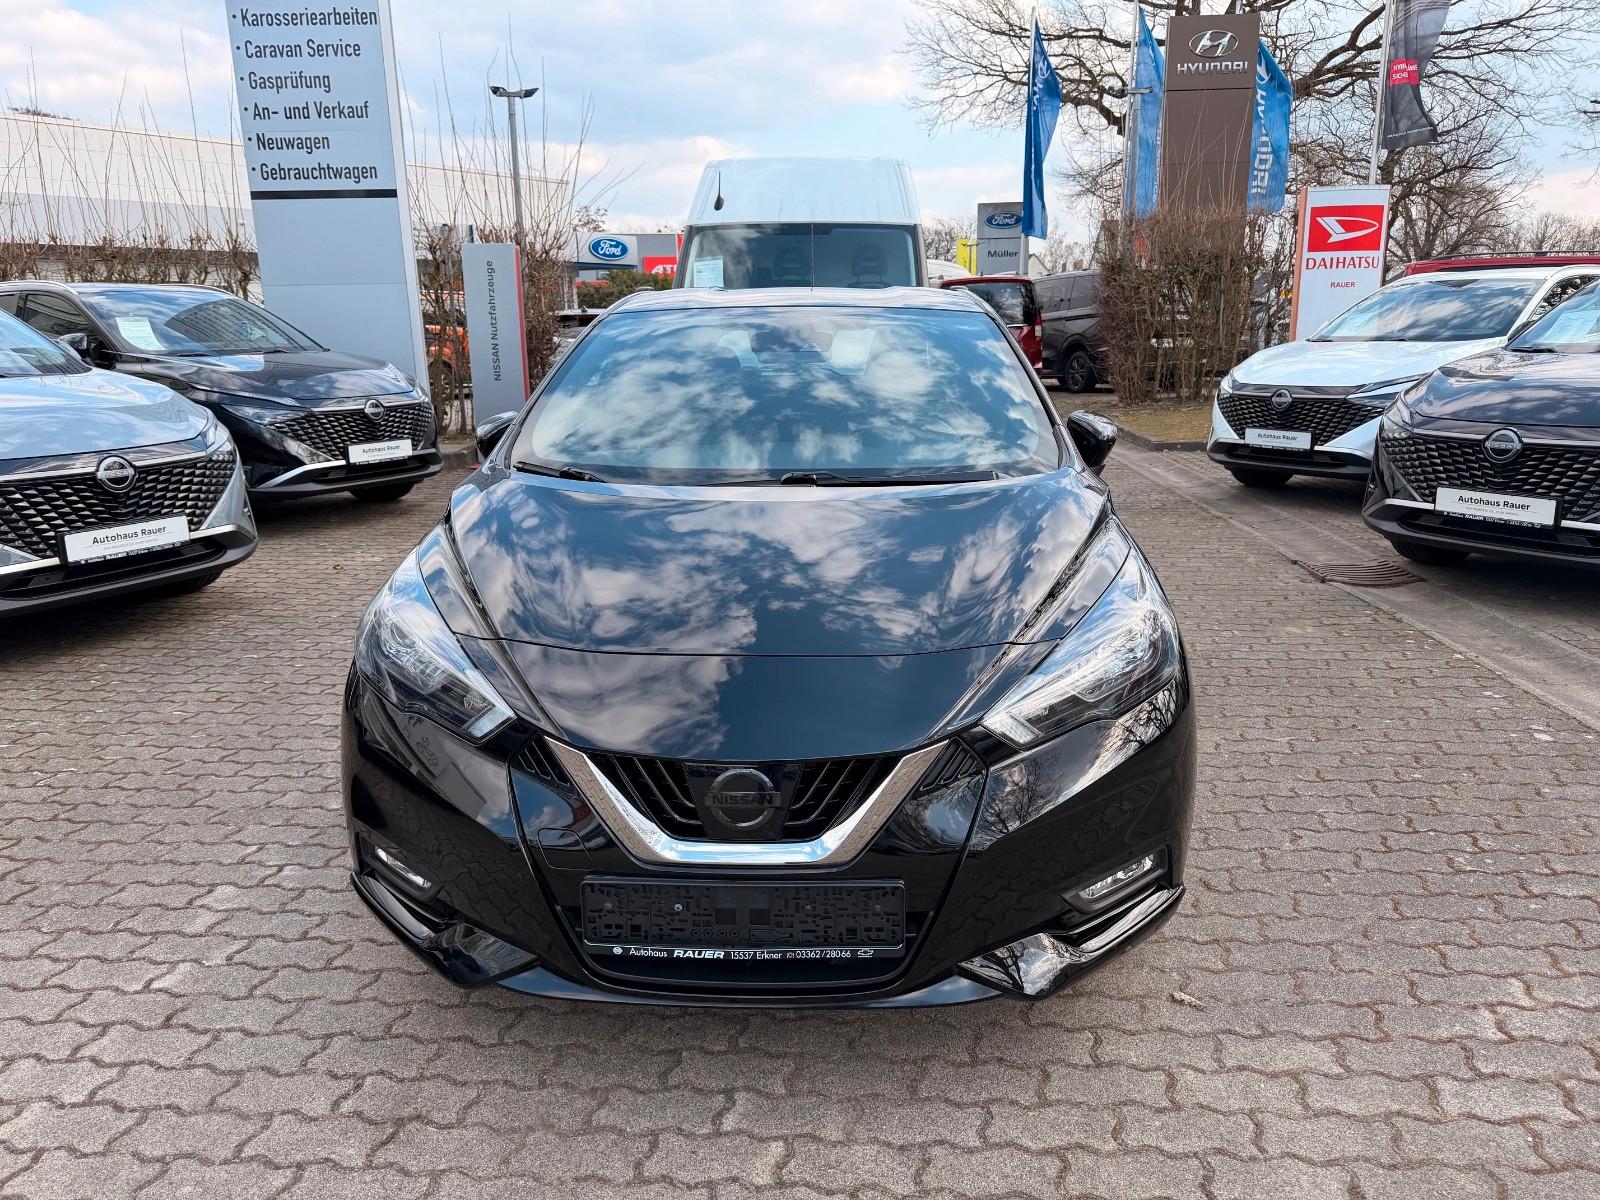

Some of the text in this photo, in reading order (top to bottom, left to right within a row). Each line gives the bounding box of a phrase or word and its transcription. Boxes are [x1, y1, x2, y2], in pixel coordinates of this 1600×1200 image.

[240, 6, 378, 27] Karosseriearbeiten
[244, 38, 361, 58] Caravan Service
[1176, 61, 1249, 74] HYUNDAI
[248, 71, 332, 94] Gasprüfung
[253, 100, 369, 120] An- und Verkauf
[256, 133, 330, 154] Neuwagen
[1252, 87, 1274, 195] HYNDAI
[260, 162, 378, 184] Gebrauchtwagen
[991, 214, 1016, 225] Ford
[598, 240, 622, 256] Ford
[987, 250, 1019, 258] Müller
[1305, 256, 1380, 270] DAIHATSU
[486, 260, 502, 381] NISSAN Nutzfahrzeuge
[1457, 495, 1501, 507] Autohaus
[1503, 501, 1531, 511] Rauer
[92, 531, 139, 545] Autohaus
[141, 526, 167, 537] Rauer
[712, 792, 773, 805] NISSAN
[629, 947, 668, 958] Autohaus
[673, 949, 725, 959] RAUER
[730, 951, 754, 960] 15537
[756, 950, 783, 959] Erkner
